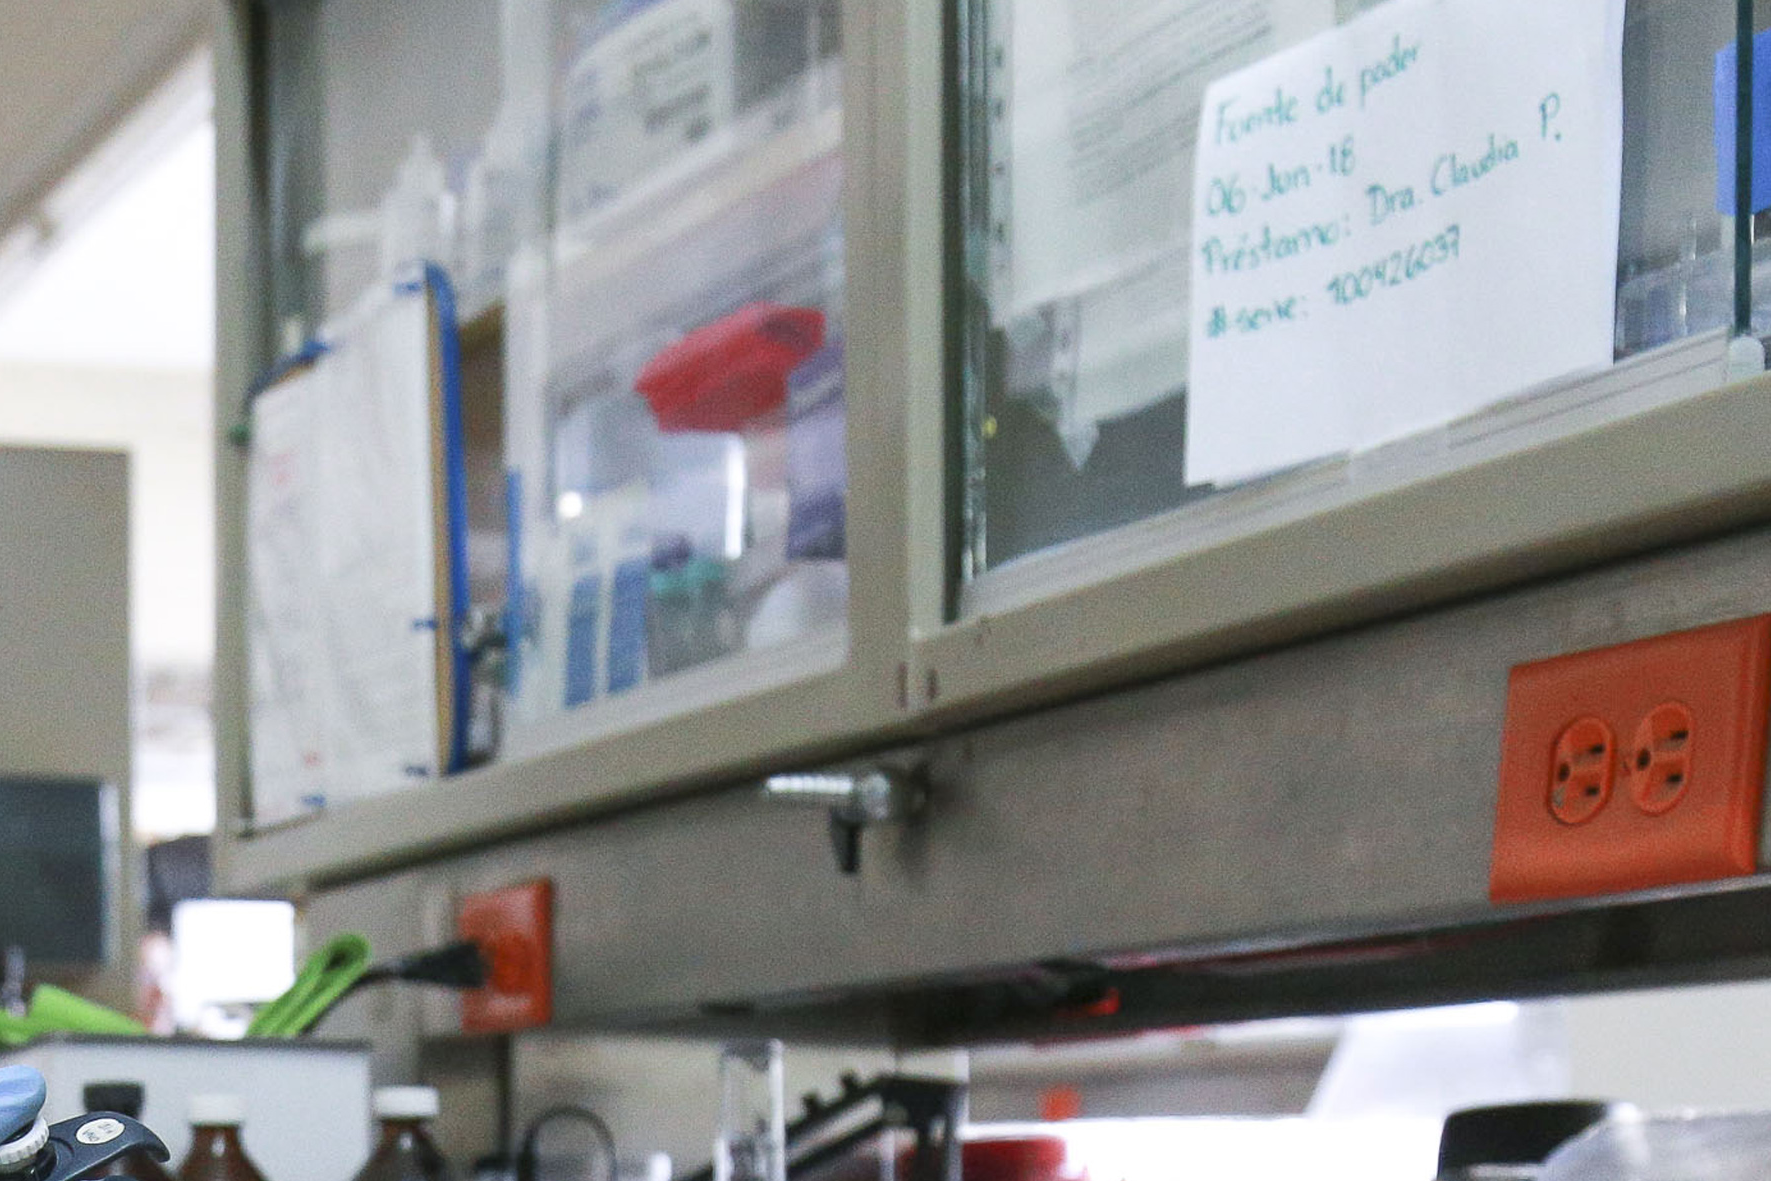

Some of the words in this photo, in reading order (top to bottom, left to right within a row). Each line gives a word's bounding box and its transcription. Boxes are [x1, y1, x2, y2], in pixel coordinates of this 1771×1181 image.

[1216, 86, 1299, 144] Fuente
[1315, 65, 1346, 114] de
[1359, 35, 1422, 110] poder
[1366, 183, 1424, 226] Dra.
[1431, 132, 1519, 196] Claudia
[1540, 92, 1561, 141] P.
